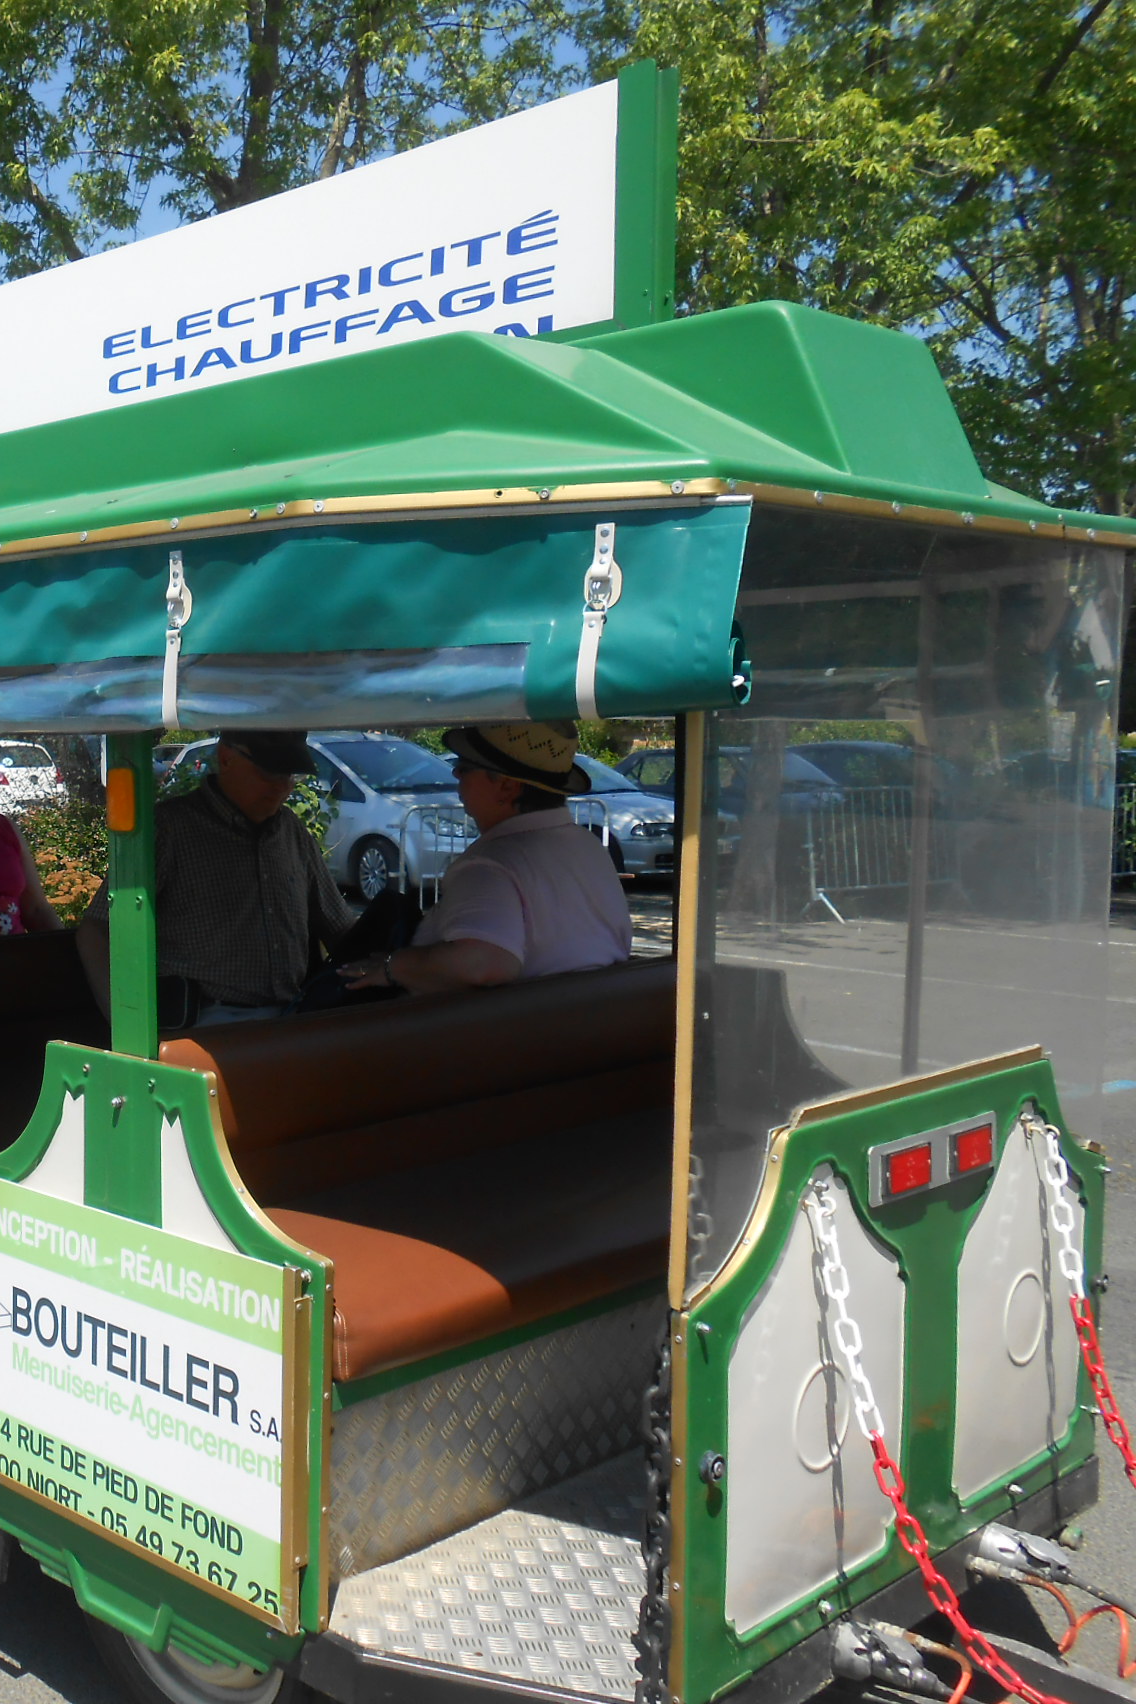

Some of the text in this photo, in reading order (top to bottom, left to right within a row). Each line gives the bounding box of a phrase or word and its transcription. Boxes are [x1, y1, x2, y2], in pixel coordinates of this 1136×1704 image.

[102, 208, 560, 360] ELECTRICITÉ
[108, 264, 556, 395] CHAUFFAGE
[12, 1286, 240, 1426] BOUTEILLER
[120, 1245, 281, 1334] RÉALISATION
[11, 1342, 282, 1489] Menuiserie-Agencement
[17, 1423, 55, 1465] RUE
[60, 1444, 87, 1481] DE
[92, 1459, 138, 1505] PIED
[145, 1486, 174, 1524] DE
[181, 1502, 243, 1556] FOND
[27, 1467, 83, 1513] NIORT
[101, 1506, 128, 1538] 05
[135, 1525, 164, 1556] 49
[171, 1540, 200, 1575] 73
[207, 1560, 239, 1592] 67
[247, 1581, 279, 1616] 25
